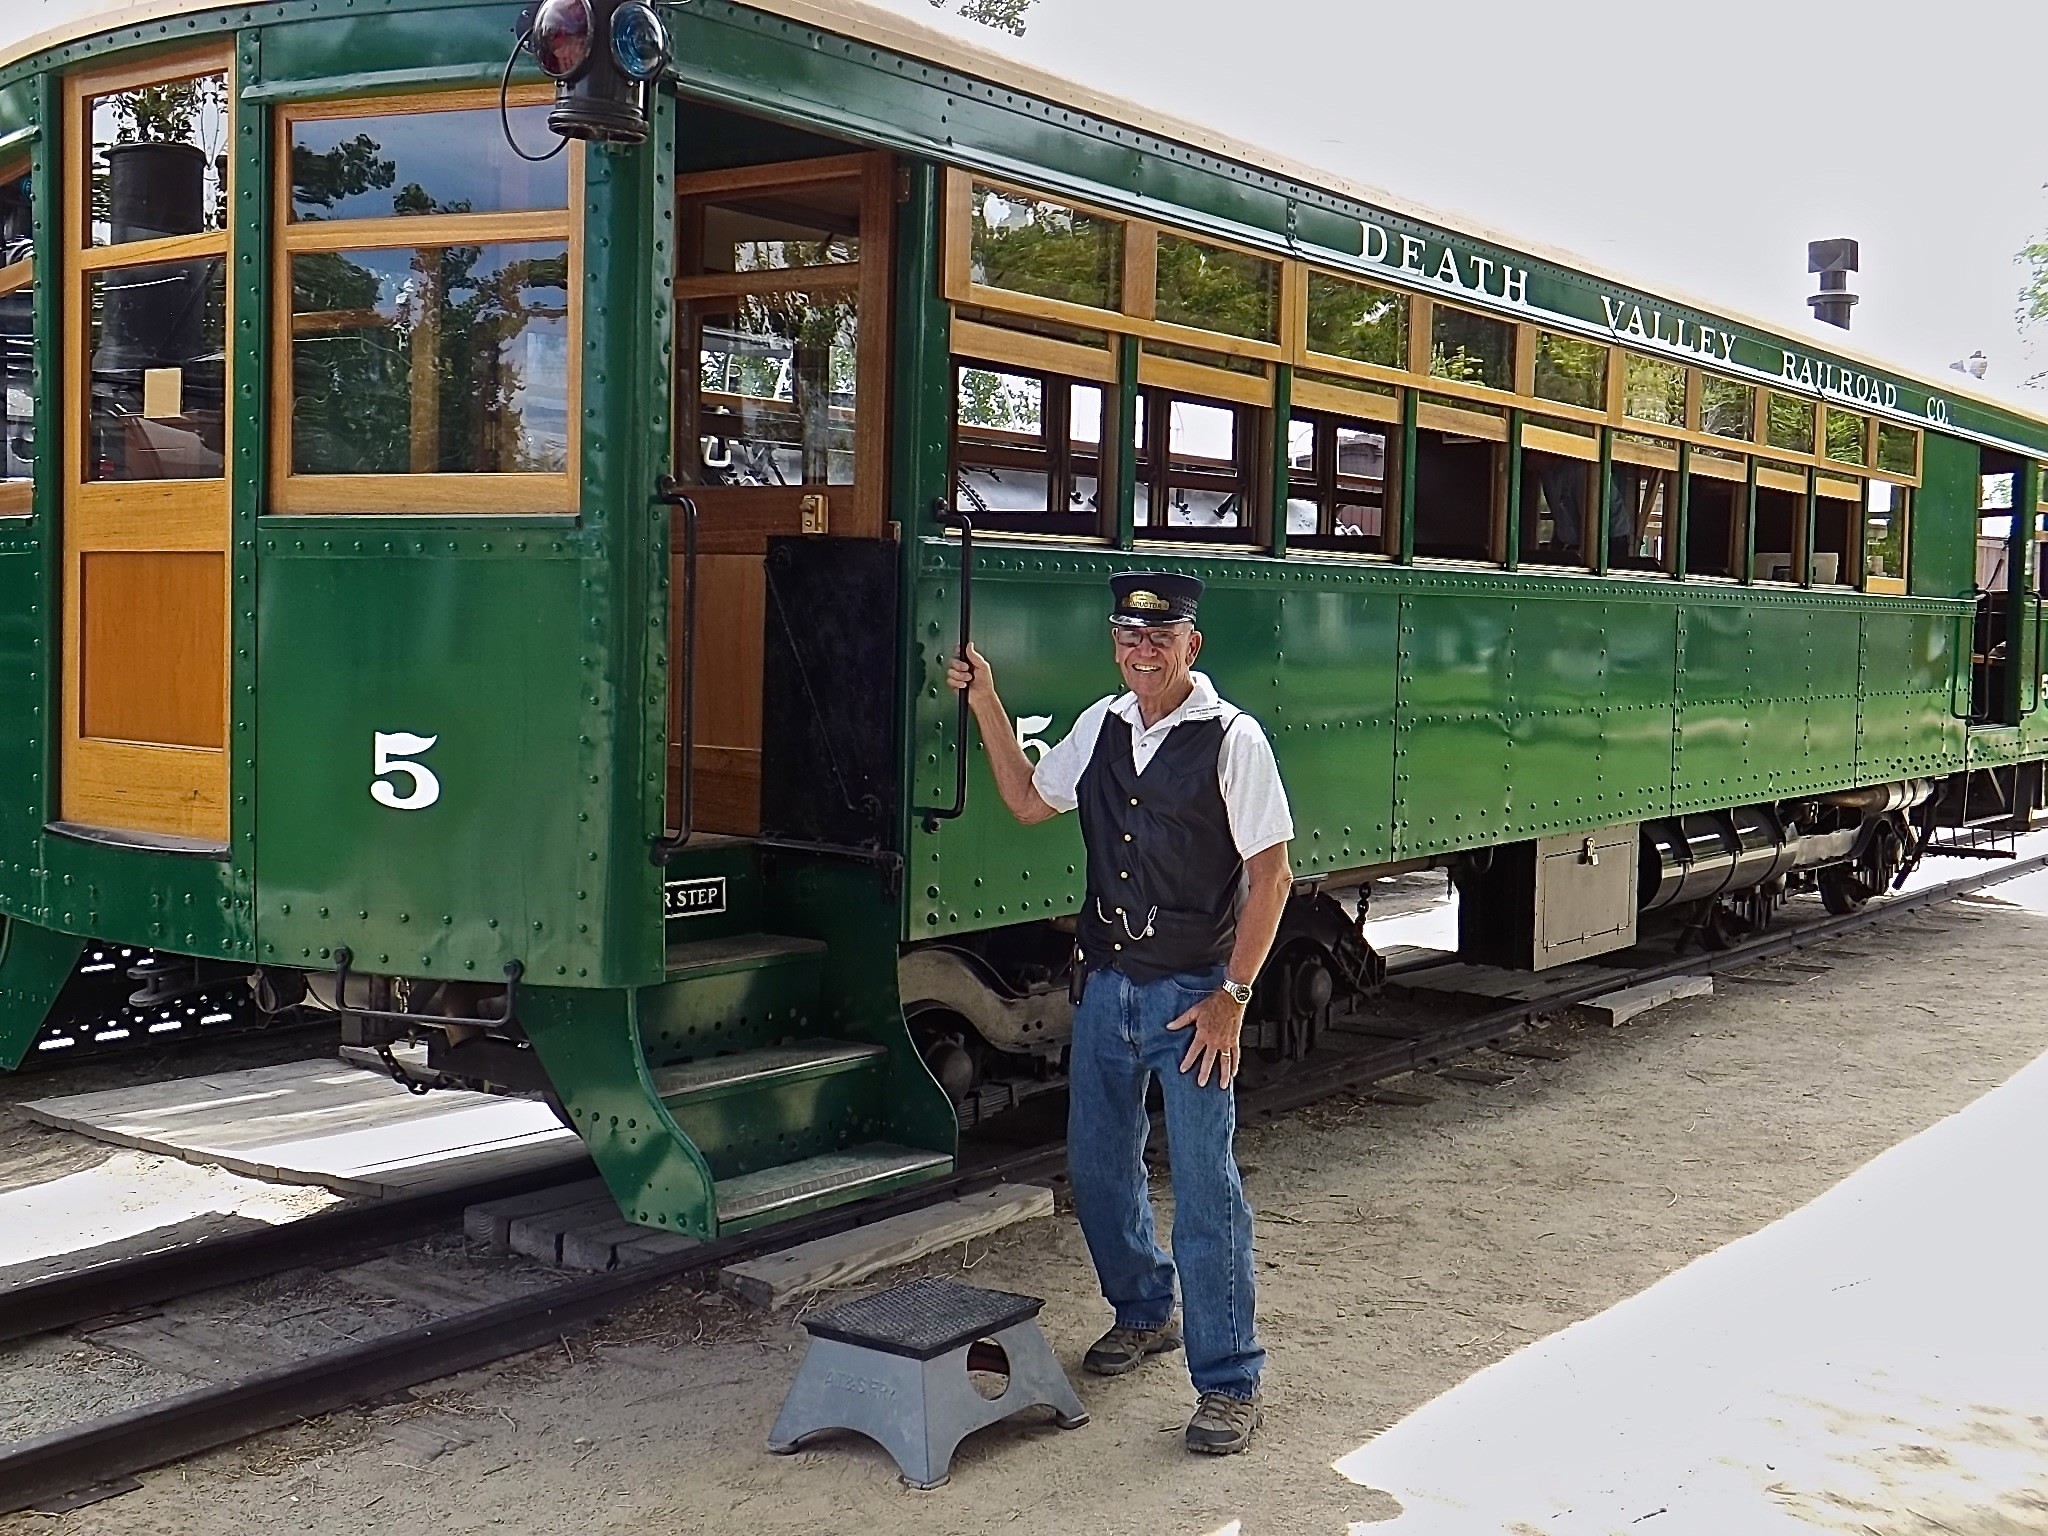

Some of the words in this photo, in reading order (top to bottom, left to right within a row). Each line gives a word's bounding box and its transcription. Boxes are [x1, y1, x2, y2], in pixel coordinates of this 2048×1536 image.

[1359, 221, 1528, 305] DEATH
[1600, 295, 1738, 363] VALLEY
[1781, 350, 1897, 408] RAILROAD
[1016, 713, 1053, 763] 5
[370, 731, 440, 810] 5
[676, 887, 718, 907] STEP
